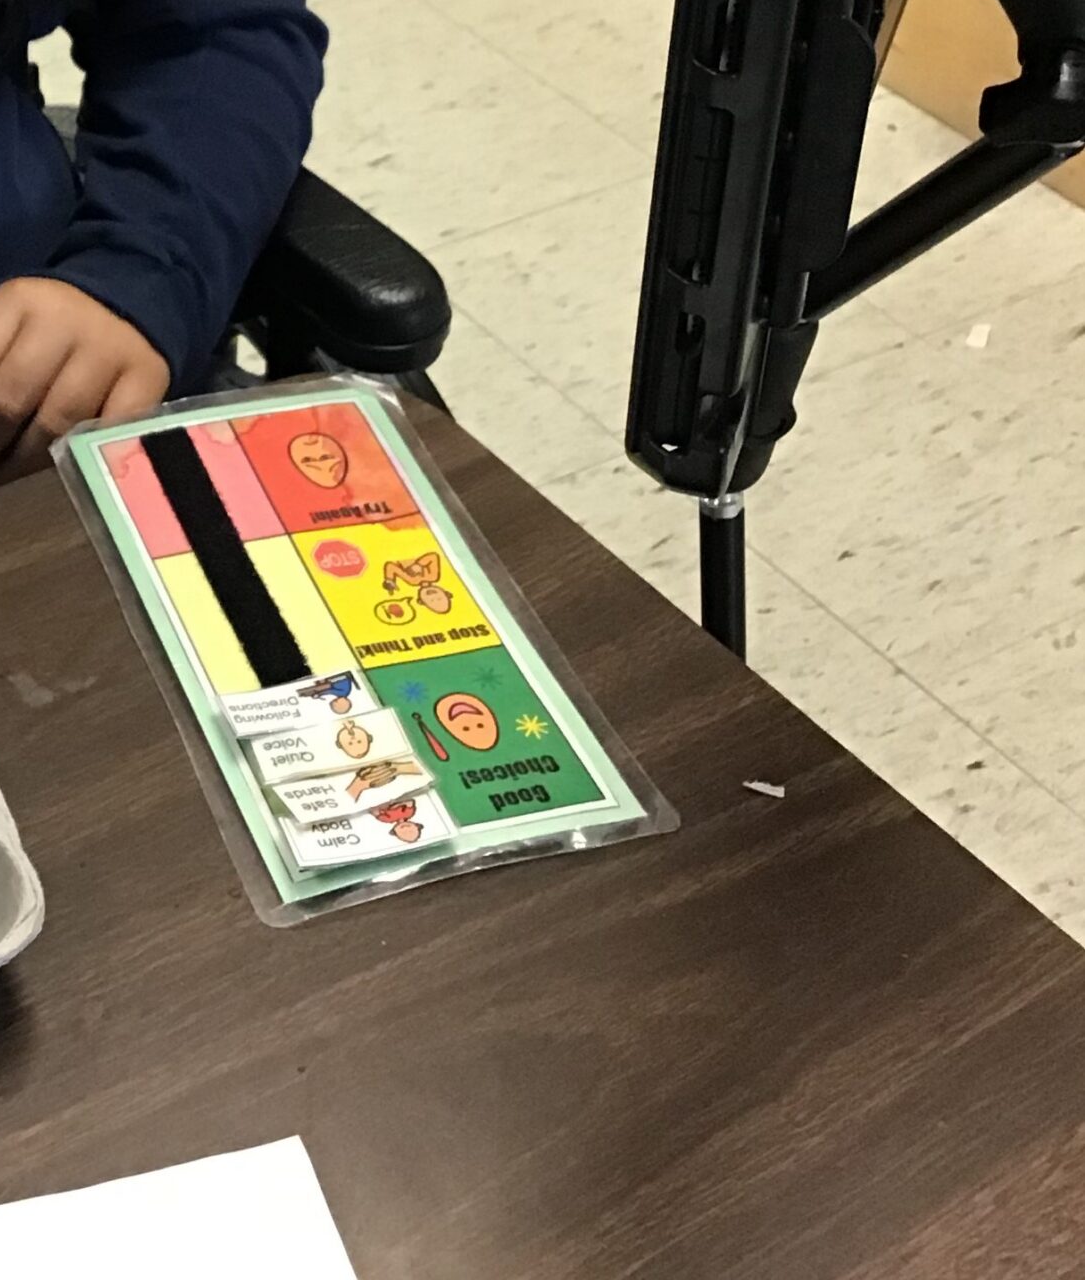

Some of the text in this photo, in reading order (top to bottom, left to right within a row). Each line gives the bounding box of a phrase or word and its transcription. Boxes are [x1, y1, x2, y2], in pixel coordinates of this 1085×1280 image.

[310, 500, 394, 523] Try Again!
[320, 550, 361, 568] STOP
[355, 624, 491, 659] Stop and Think!
[228, 696, 299, 712] Directions
[233, 709, 301, 724] Following
[262, 737, 308, 751] Voice
[271, 751, 315, 767] Quiet
[458, 755, 561, 789] Choices!
[284, 784, 336, 800] Hands
[488, 784, 551, 812] Good
[300, 798, 339, 812] Safe
[311, 819, 353, 833] Body
[317, 833, 361, 848] Calm
